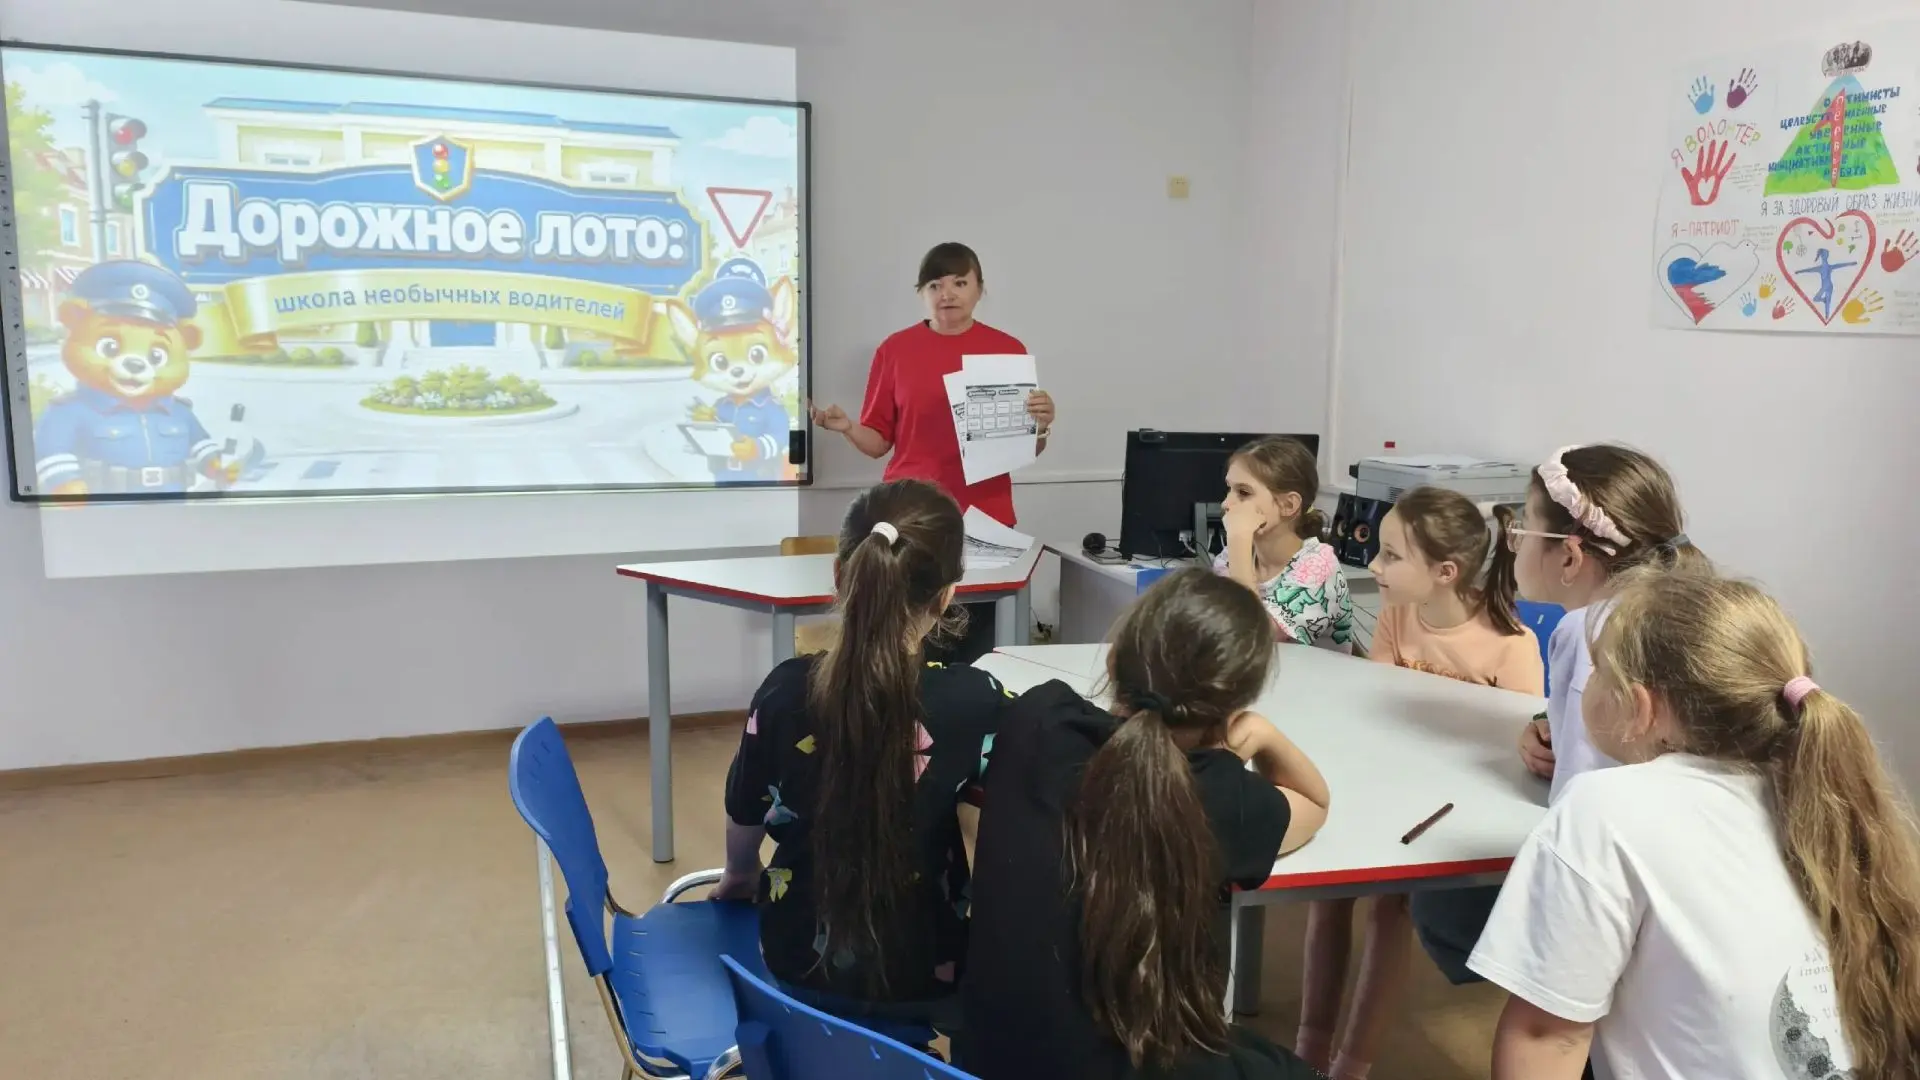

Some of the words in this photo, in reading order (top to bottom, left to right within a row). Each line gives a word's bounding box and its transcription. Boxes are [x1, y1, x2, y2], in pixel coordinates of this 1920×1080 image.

[177, 181, 524, 263] Дорожное
[532, 211, 686, 261] лото:
[1759, 201, 1768, 217] Я
[1772, 198, 1785, 216] ЗА
[1788, 192, 1840, 216] ЗДОРОВЫЙ
[1845, 194, 1878, 211] ОБРАЗ
[275, 287, 356, 314] школа
[364, 283, 500, 306] необычных
[509, 290, 625, 321] водителей
